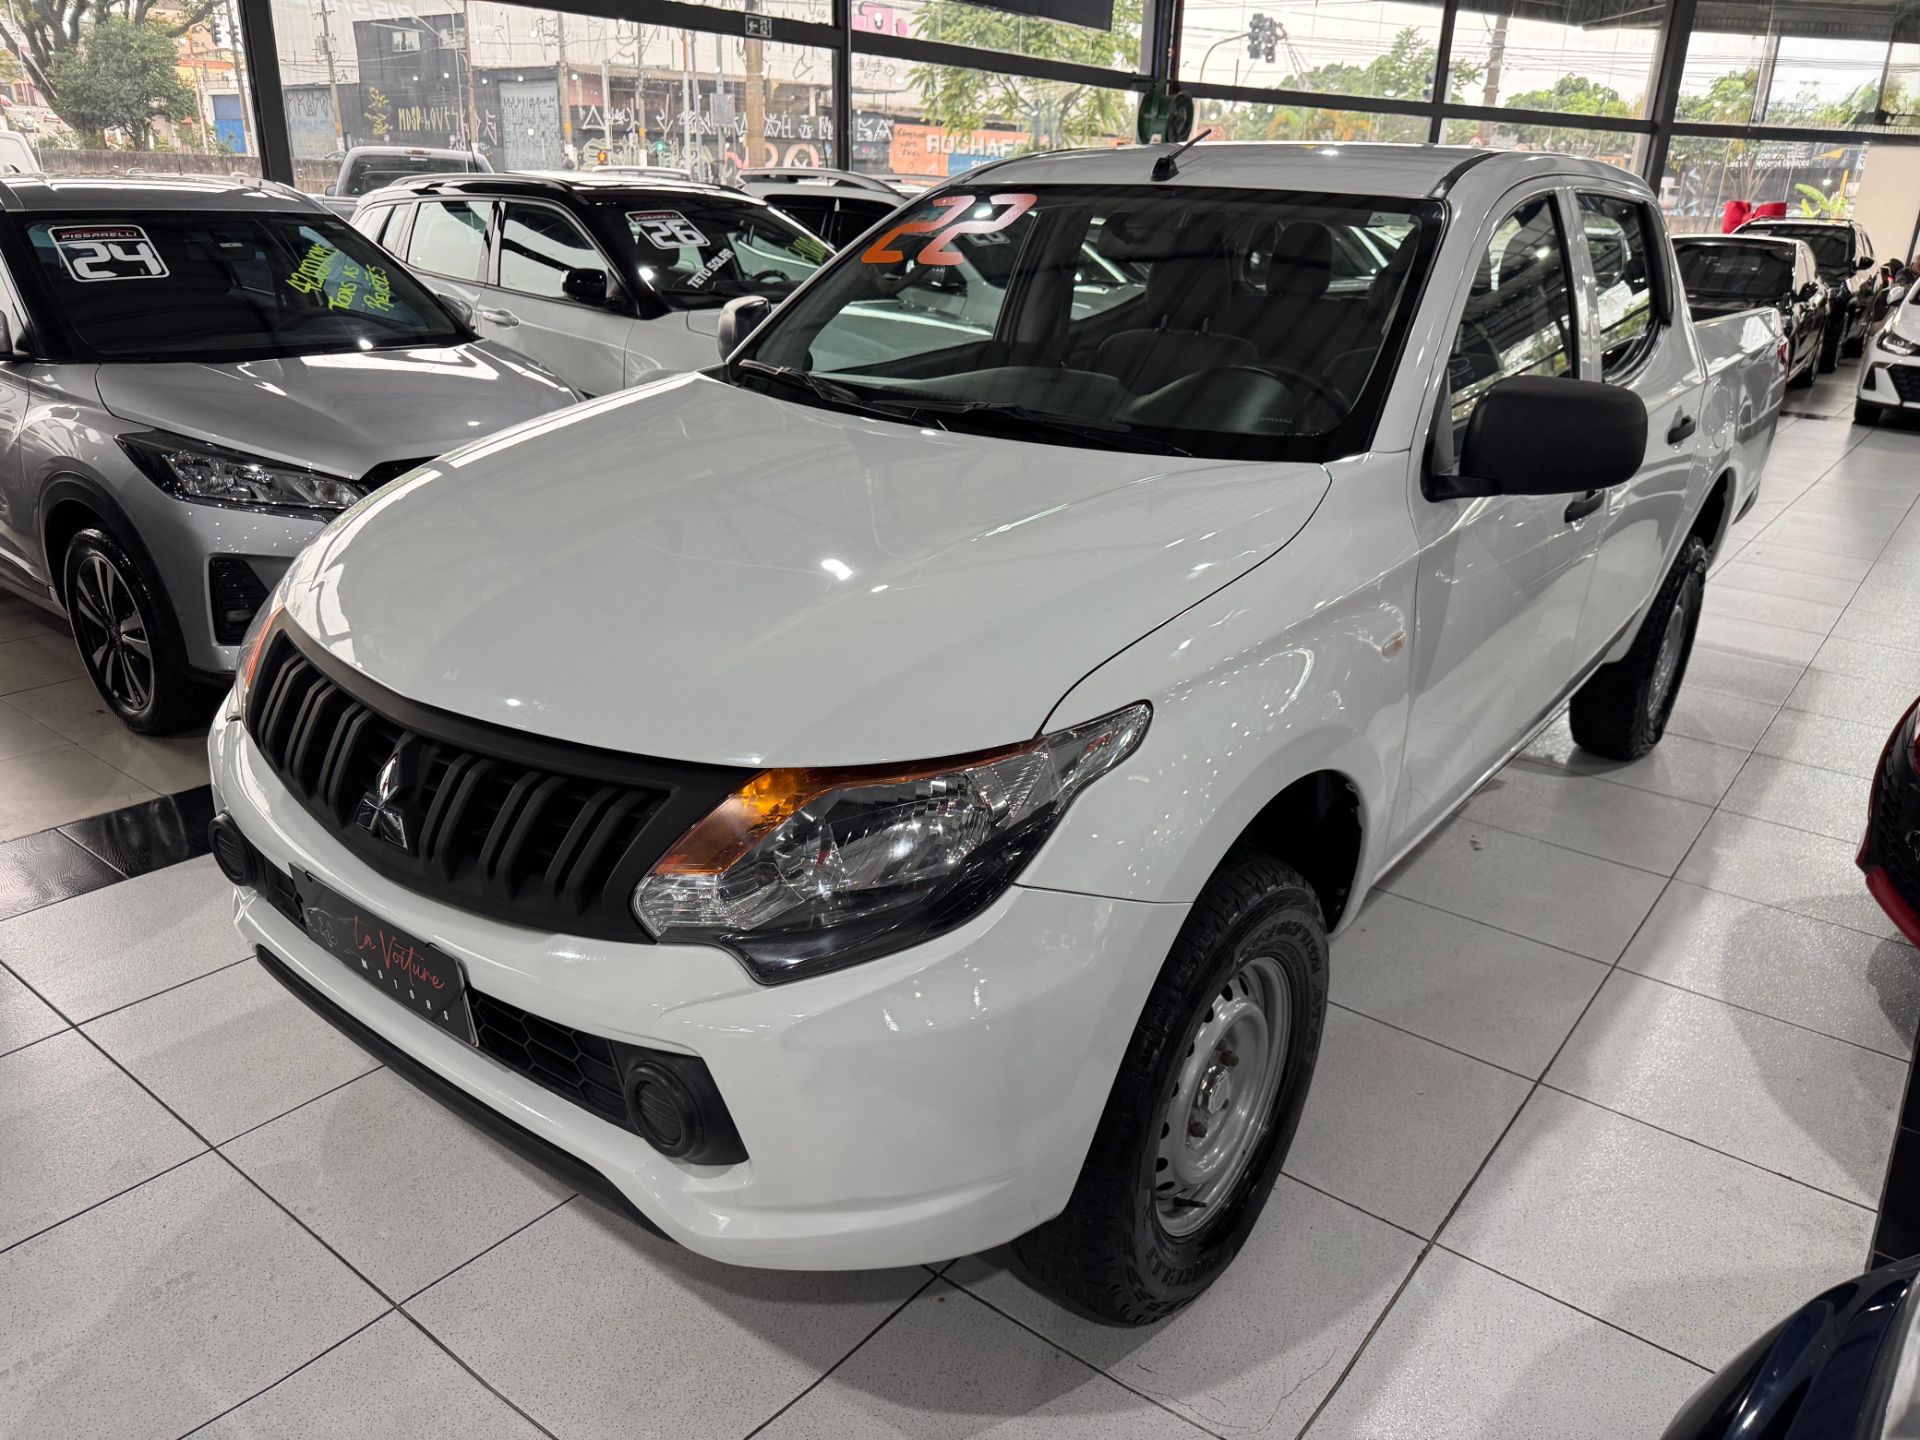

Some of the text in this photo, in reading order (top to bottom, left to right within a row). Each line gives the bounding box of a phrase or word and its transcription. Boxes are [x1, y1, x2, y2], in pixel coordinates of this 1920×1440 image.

[62, 231, 137, 239] PISSARELLI
[641, 221, 706, 247] 26
[861, 194, 1038, 266] 22
[67, 242, 162, 279] 24
[686, 248, 735, 289] TETO SOLAR
[379, 929, 445, 990] Voiture
